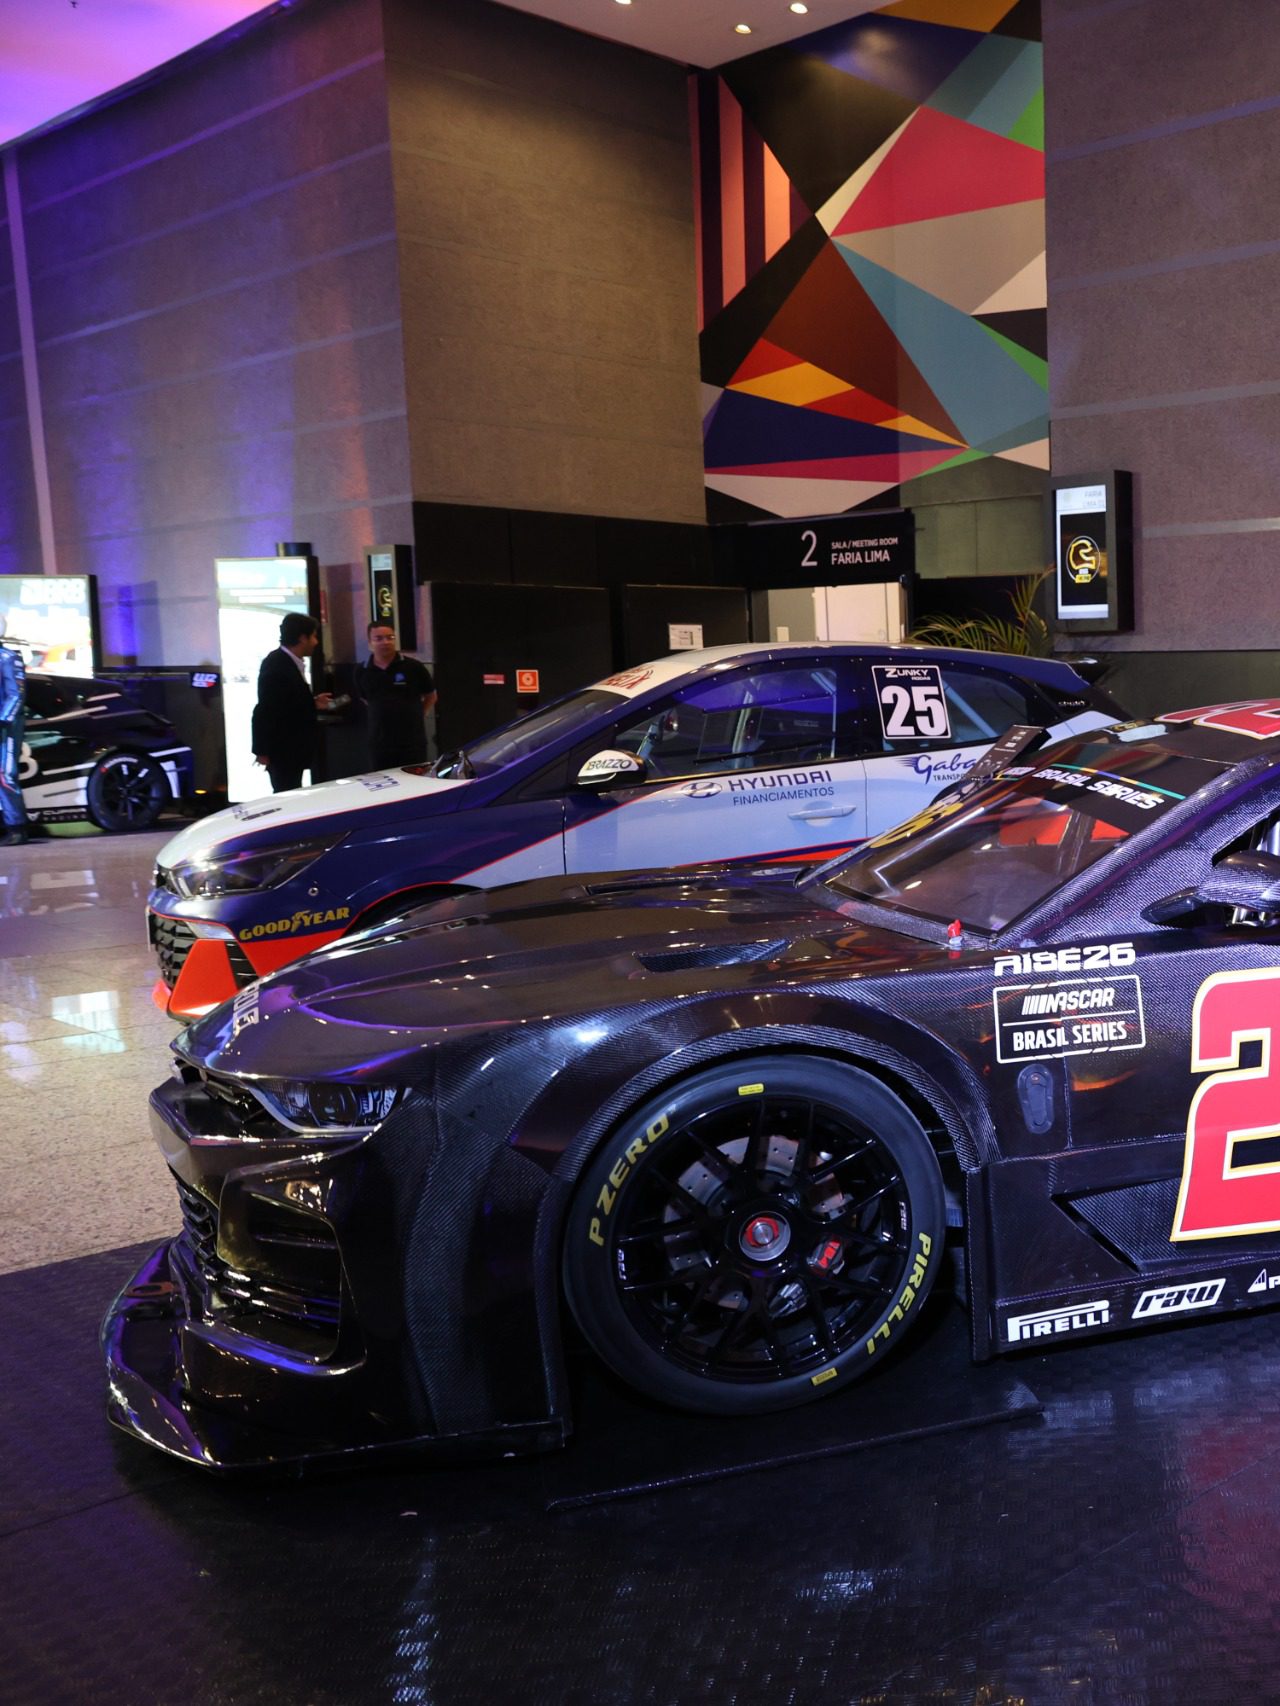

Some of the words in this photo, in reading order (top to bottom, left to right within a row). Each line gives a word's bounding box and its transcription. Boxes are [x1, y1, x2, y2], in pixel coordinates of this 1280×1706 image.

[801, 530, 818, 567] 2
[831, 541, 848, 550] SALA
[852, 539, 878, 548] MEETING
[879, 537, 898, 546] ROOM
[831, 552, 862, 566] FARIA
[865, 549, 890, 564] LIMA
[885, 668, 928, 678] ZUNKY
[881, 685, 947, 736] 25
[729, 770, 832, 792] HYUNDAI
[733, 786, 834, 806] FINANCIAMENTOS
[1032, 769, 1092, 787] BRASIL
[1087, 780, 1165, 809] SERIES
[1046, 988, 1115, 1013] NASCAR
[1013, 1027, 1069, 1052] BRASIL
[1072, 1021, 1127, 1044] SERIES
[589, 1217, 605, 1247] P
[597, 1113, 670, 1216] ZERO
[866, 1232, 932, 1355] PIRELLI
[1008, 1300, 1110, 1342] PIRELLI
